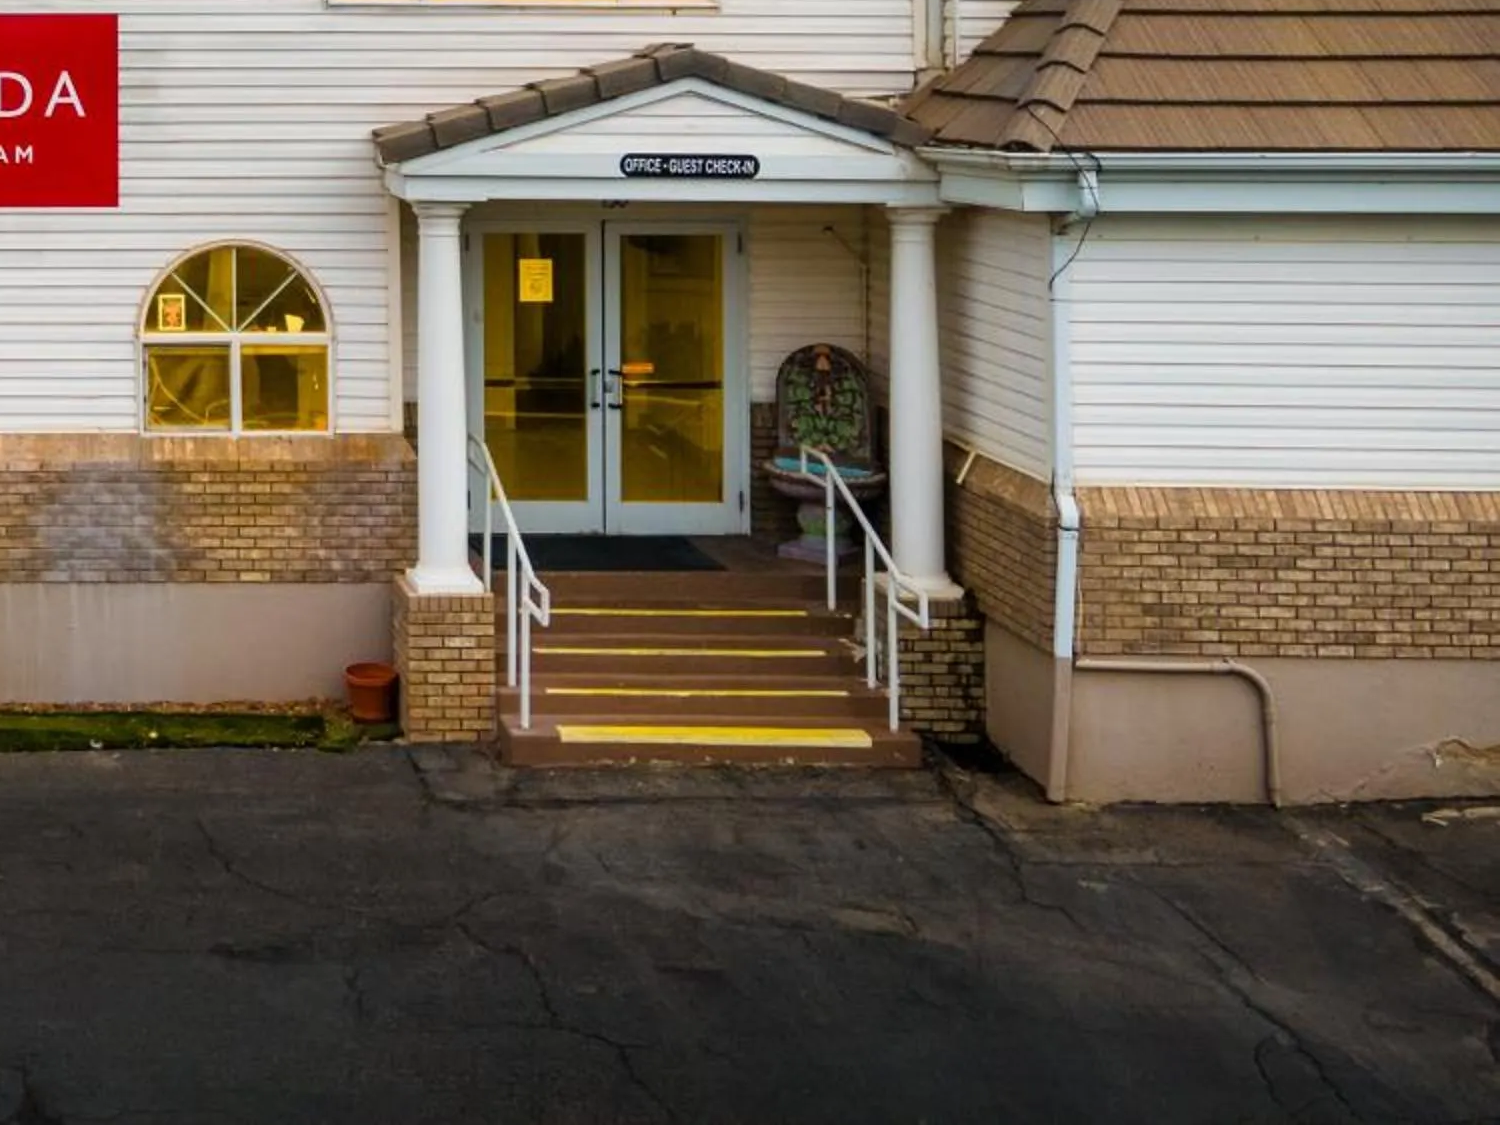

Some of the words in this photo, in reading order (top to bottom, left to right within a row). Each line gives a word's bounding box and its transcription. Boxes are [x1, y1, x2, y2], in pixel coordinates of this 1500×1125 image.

[624, 158, 662, 172] OFFICE
[669, 158, 703, 174] GUEST
[705, 159, 755, 174] CHECK-IN
